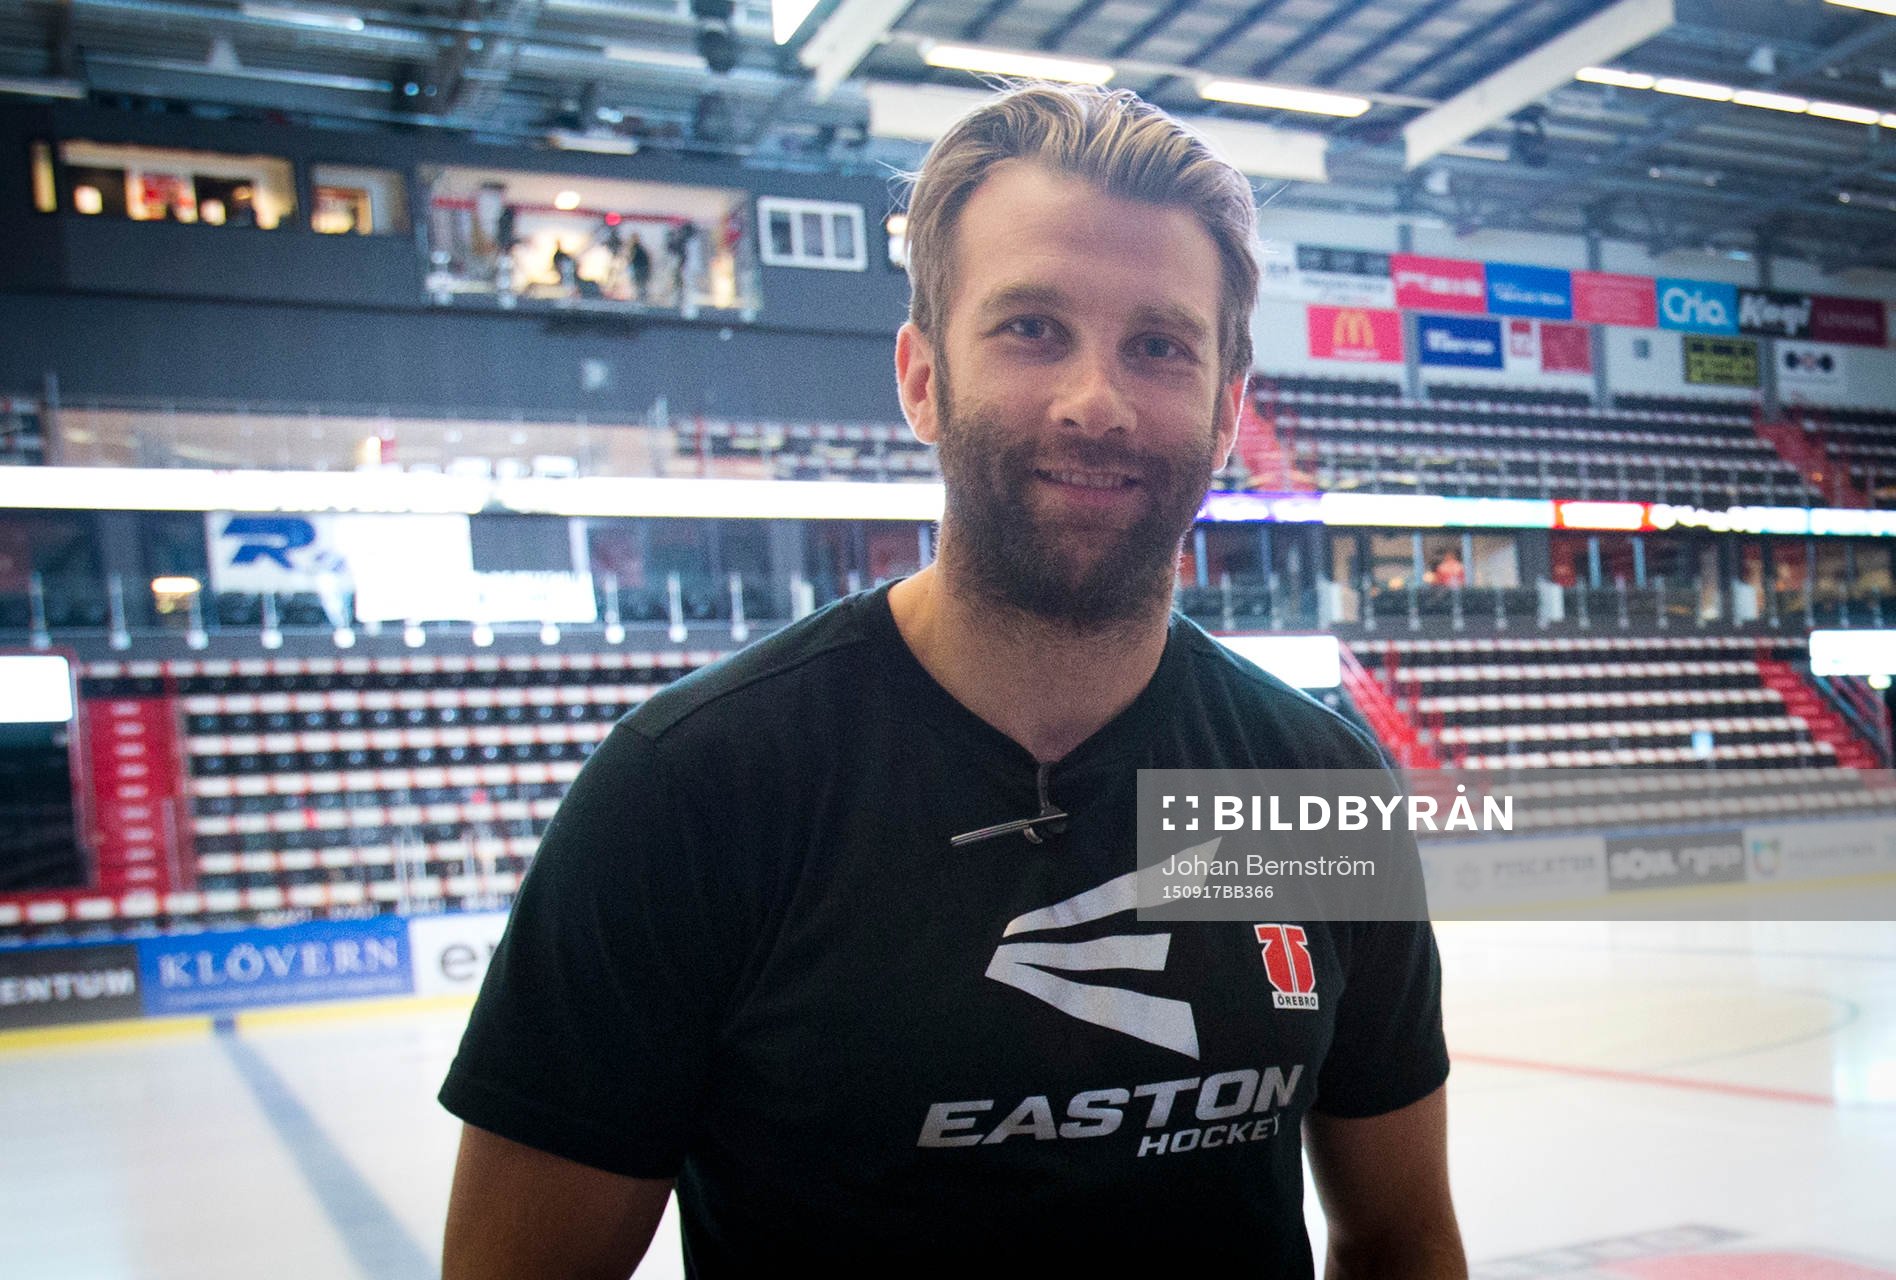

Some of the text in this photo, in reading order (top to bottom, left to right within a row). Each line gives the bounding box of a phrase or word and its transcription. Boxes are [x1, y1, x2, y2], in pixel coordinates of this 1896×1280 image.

[157, 937, 400, 988] KLÖVERN
[1277, 995, 1317, 1007] ÖREBRO
[917, 1064, 1304, 1147] EASTON
